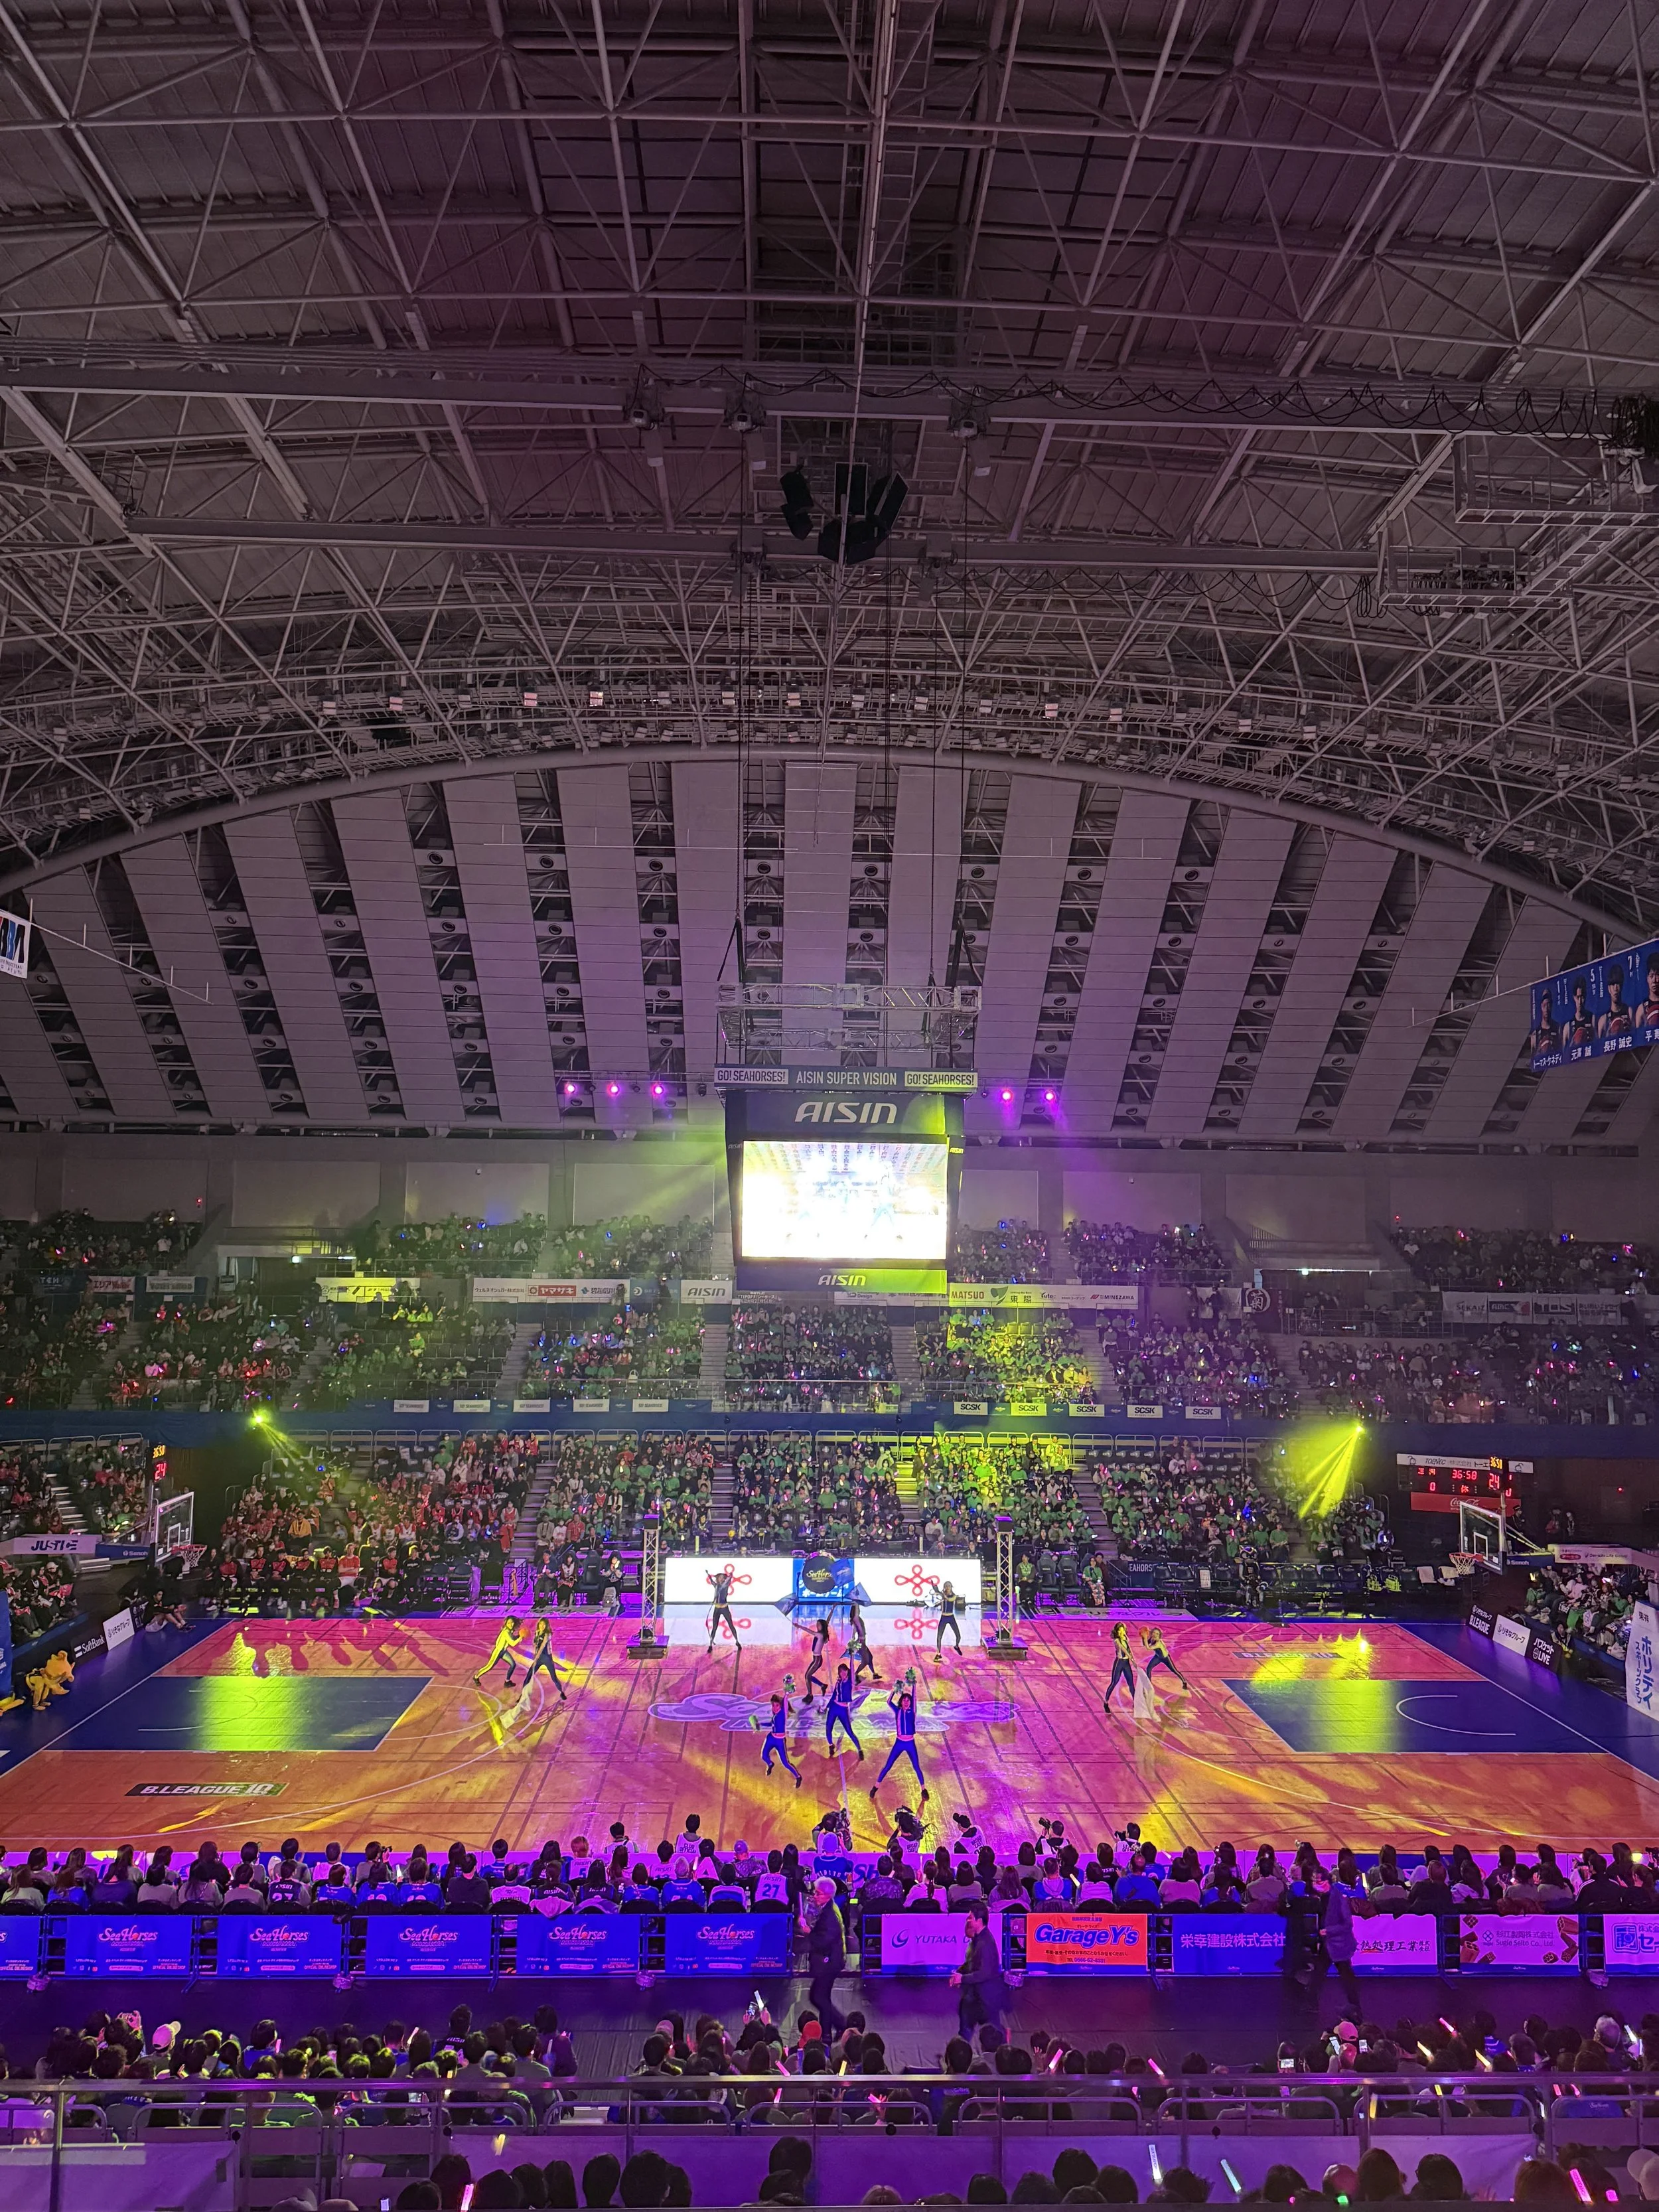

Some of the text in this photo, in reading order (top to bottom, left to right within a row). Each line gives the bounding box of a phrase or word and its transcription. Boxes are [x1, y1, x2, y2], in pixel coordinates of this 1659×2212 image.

[717, 1070, 786, 1082] GO! SEAHORSES!
[796, 1071, 897, 1086] AISIN SUPER VISION
[906, 1072, 975, 1086] GO! SEAHORSES!
[795, 1102, 897, 1124] AISIN
[818, 1274, 866, 1286] AISIN
[687, 1288, 726, 1297] AISIN
[951, 1291, 985, 1299] MATSUO
[1452, 1469, 1477, 1481] 36:58
[1429, 1482, 1436, 1492] 0
[1129, 1563, 1153, 1572] EAHORS
[111, 1618, 130, 1635] りそなグループ
[1502, 1628, 1526, 1643] りそなグループ
[82, 1635, 106, 1654] SoftBank
[1533, 1637, 1555, 1655] バスケット
[1538, 1652, 1551, 1665] LIVE
[1641, 1636, 1654, 1710] ホリデイ
[140, 1785, 244, 1794] B.LEAGUE
[762, 1883, 780, 1898] 27
[98, 1925, 158, 1941] SeaHorses
[250, 1925, 309, 1941] SeaHorses
[399, 1925, 459, 1941] SeaHorses
[549, 1924, 607, 1940] SeaHorses
[697, 1923, 755, 1940] SeaHorses
[1035, 1923, 1139, 1949] GarageY's
[915, 1935, 958, 1945] YUTAKA
[1181, 1932, 1286, 1949] 栄幸建設株式会社
